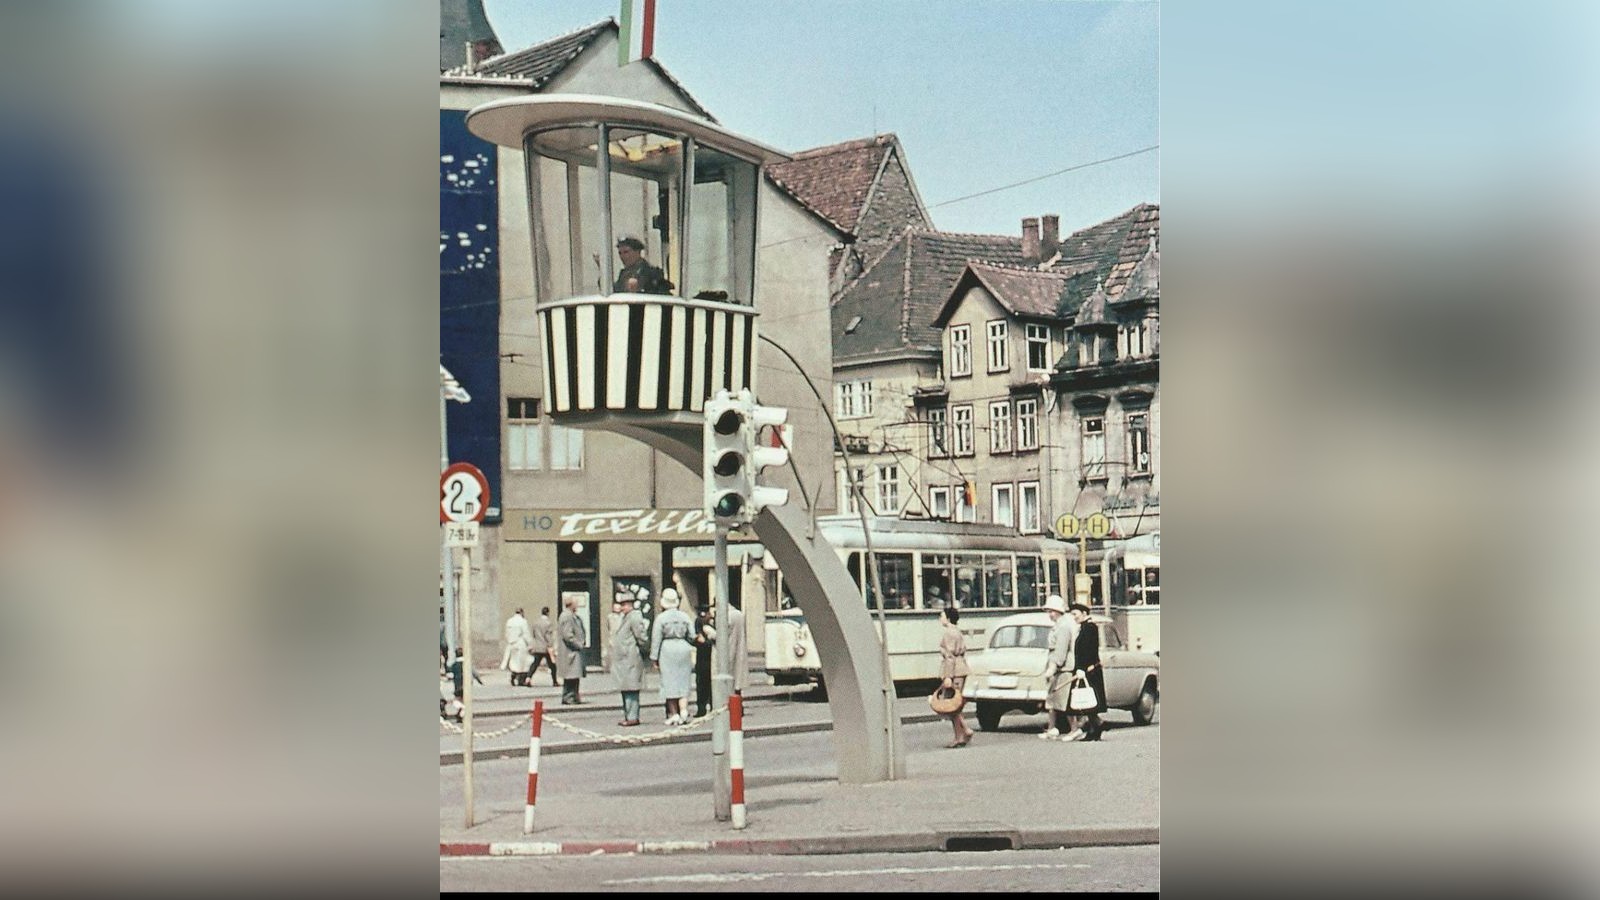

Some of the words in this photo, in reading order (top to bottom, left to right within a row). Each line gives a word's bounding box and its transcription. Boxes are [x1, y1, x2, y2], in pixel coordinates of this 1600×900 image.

[450, 479, 463, 514] 2
[465, 502, 474, 515] m
[523, 515, 553, 531] HO
[1062, 517, 1074, 534] H
[1092, 517, 1104, 534] H
